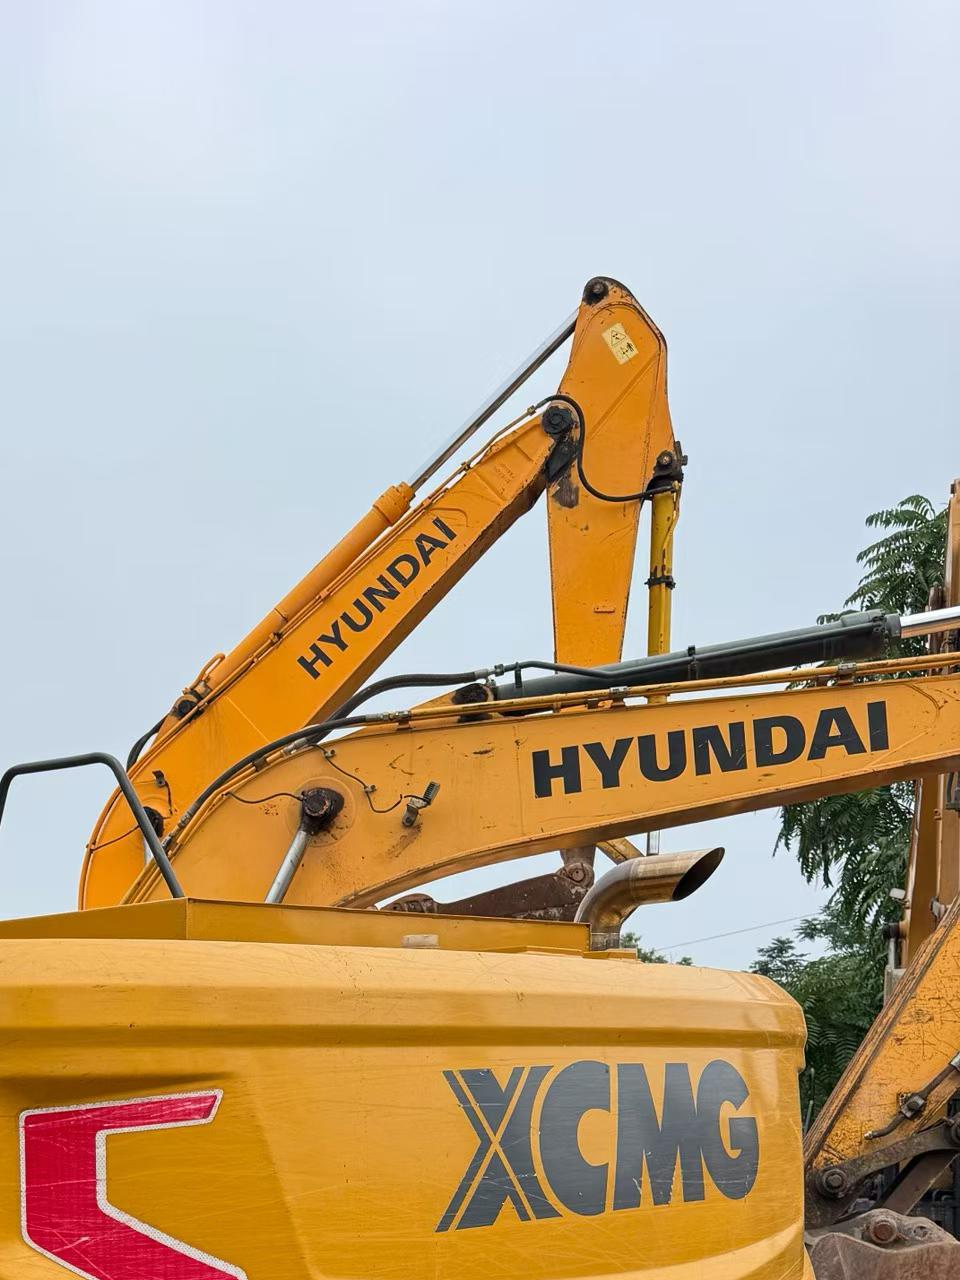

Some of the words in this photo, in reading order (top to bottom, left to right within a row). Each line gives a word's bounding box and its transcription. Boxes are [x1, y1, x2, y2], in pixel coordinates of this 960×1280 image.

[297, 516, 457, 681] HYUNDAI
[532, 701, 890, 799] HYUNDAI
[433, 1059, 760, 1233] XCMG
